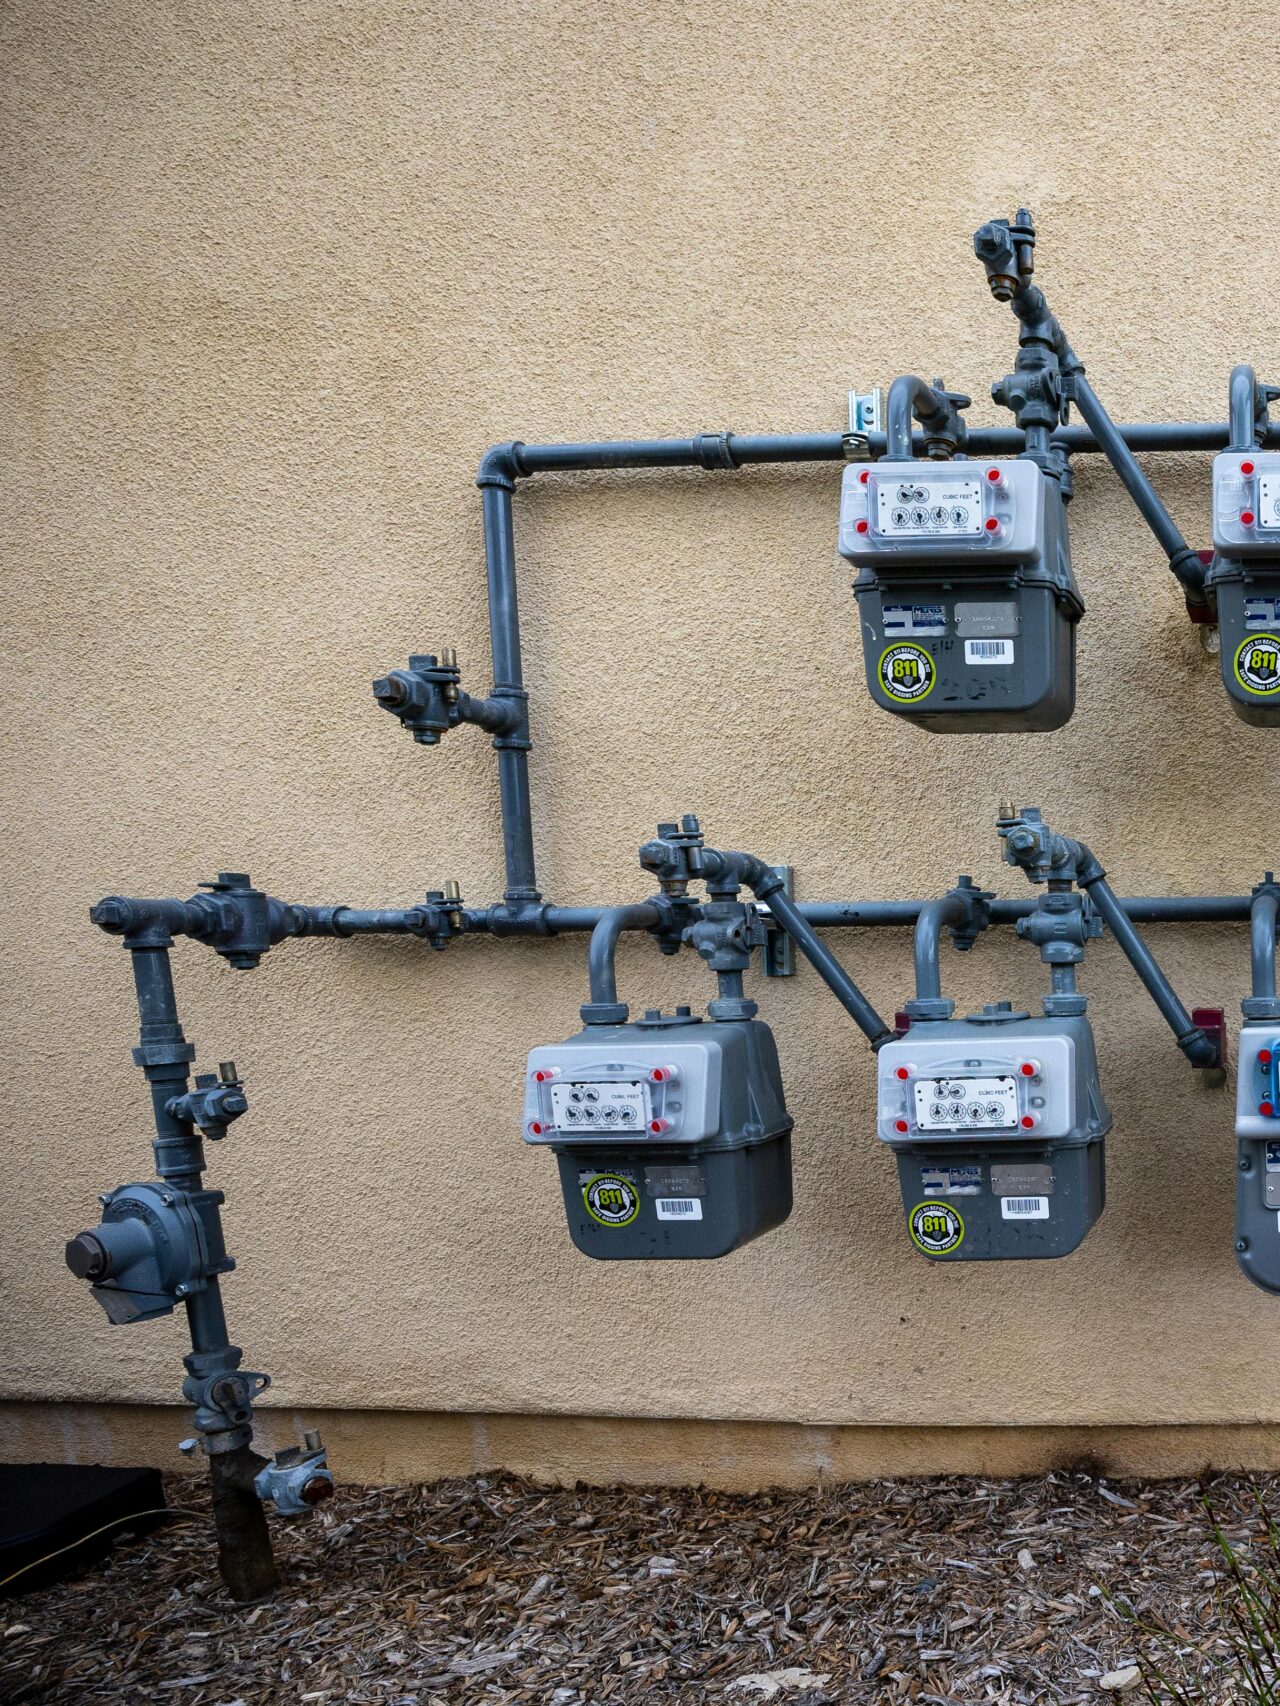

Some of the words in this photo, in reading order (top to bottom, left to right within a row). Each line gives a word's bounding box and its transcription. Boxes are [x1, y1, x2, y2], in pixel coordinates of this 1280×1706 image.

[1239, 641, 1254, 661] CONTACT
[1262, 638, 1280, 649] BEFORE
[1250, 649, 1277, 670] 811
[882, 652, 893, 673] CONTACT
[900, 647, 920, 655] BEFORE
[893, 658, 917, 677] 811
[598, 1188, 623, 1205] 811
[923, 1215, 946, 1232] 811
